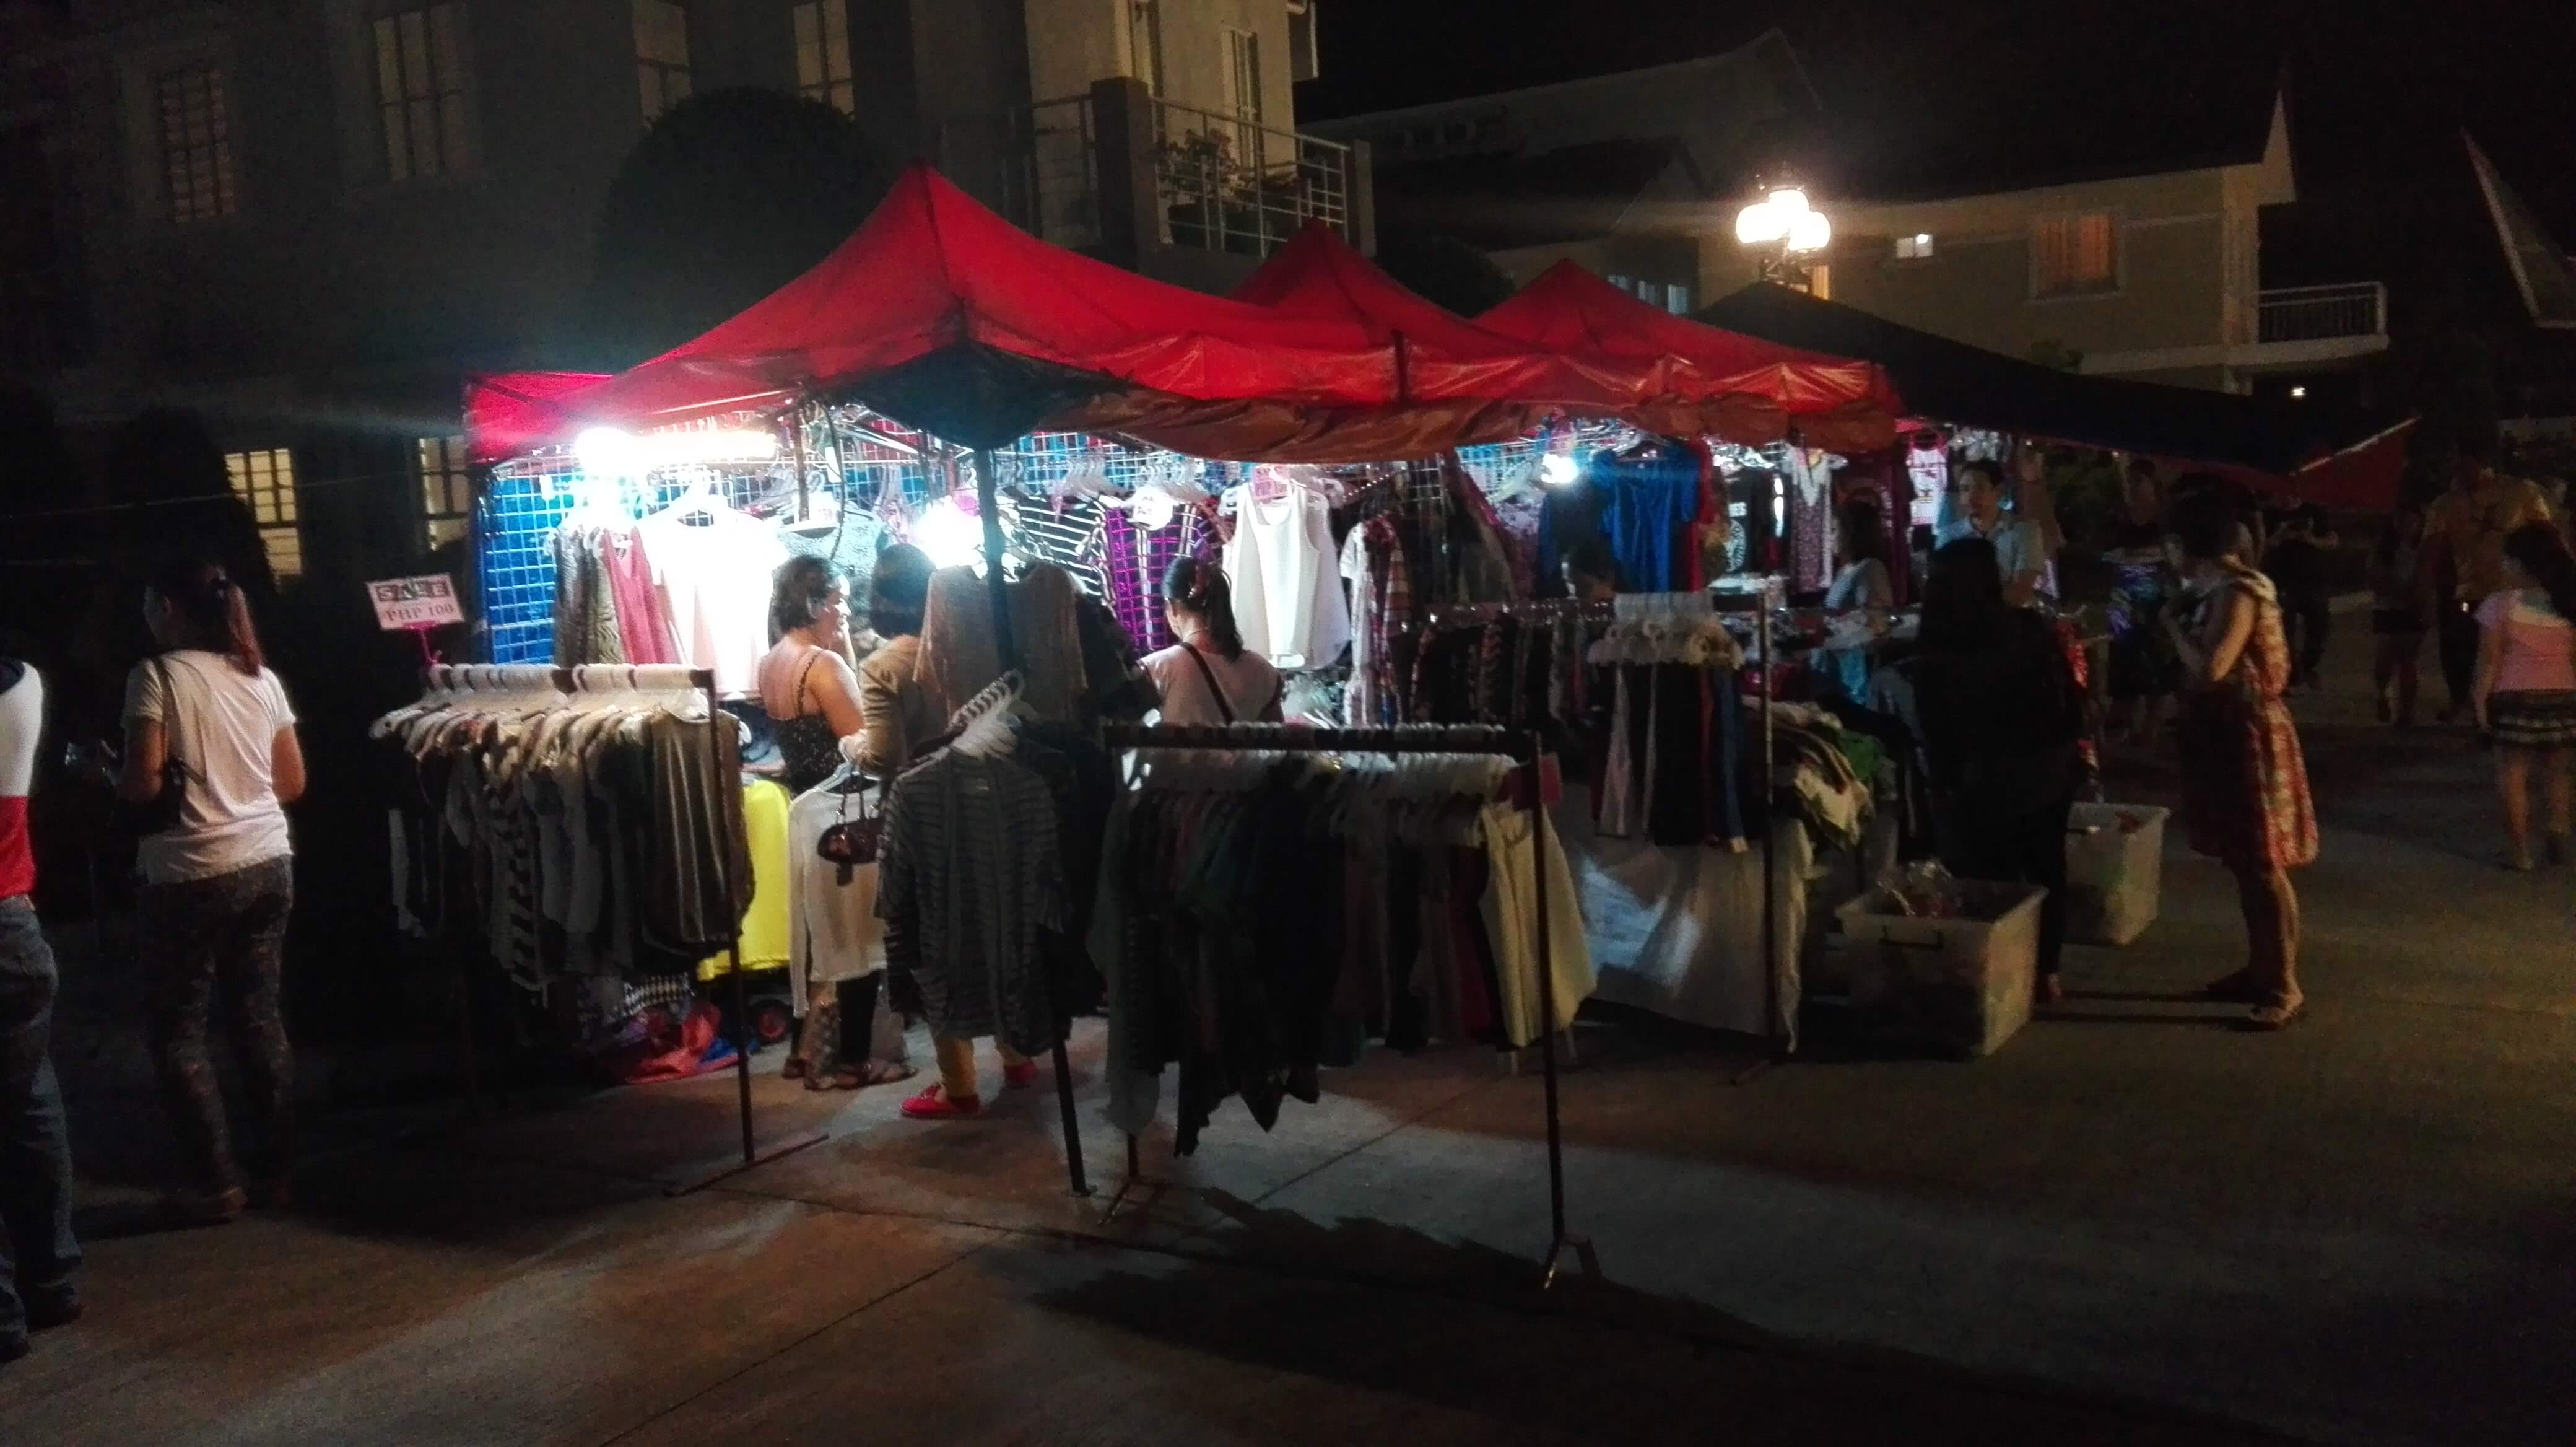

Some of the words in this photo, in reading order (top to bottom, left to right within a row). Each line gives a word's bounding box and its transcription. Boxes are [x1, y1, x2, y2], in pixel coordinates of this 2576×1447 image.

[376, 580, 450, 602] SALE
[386, 607, 421, 621] PHP
[429, 604, 454, 616] 100
